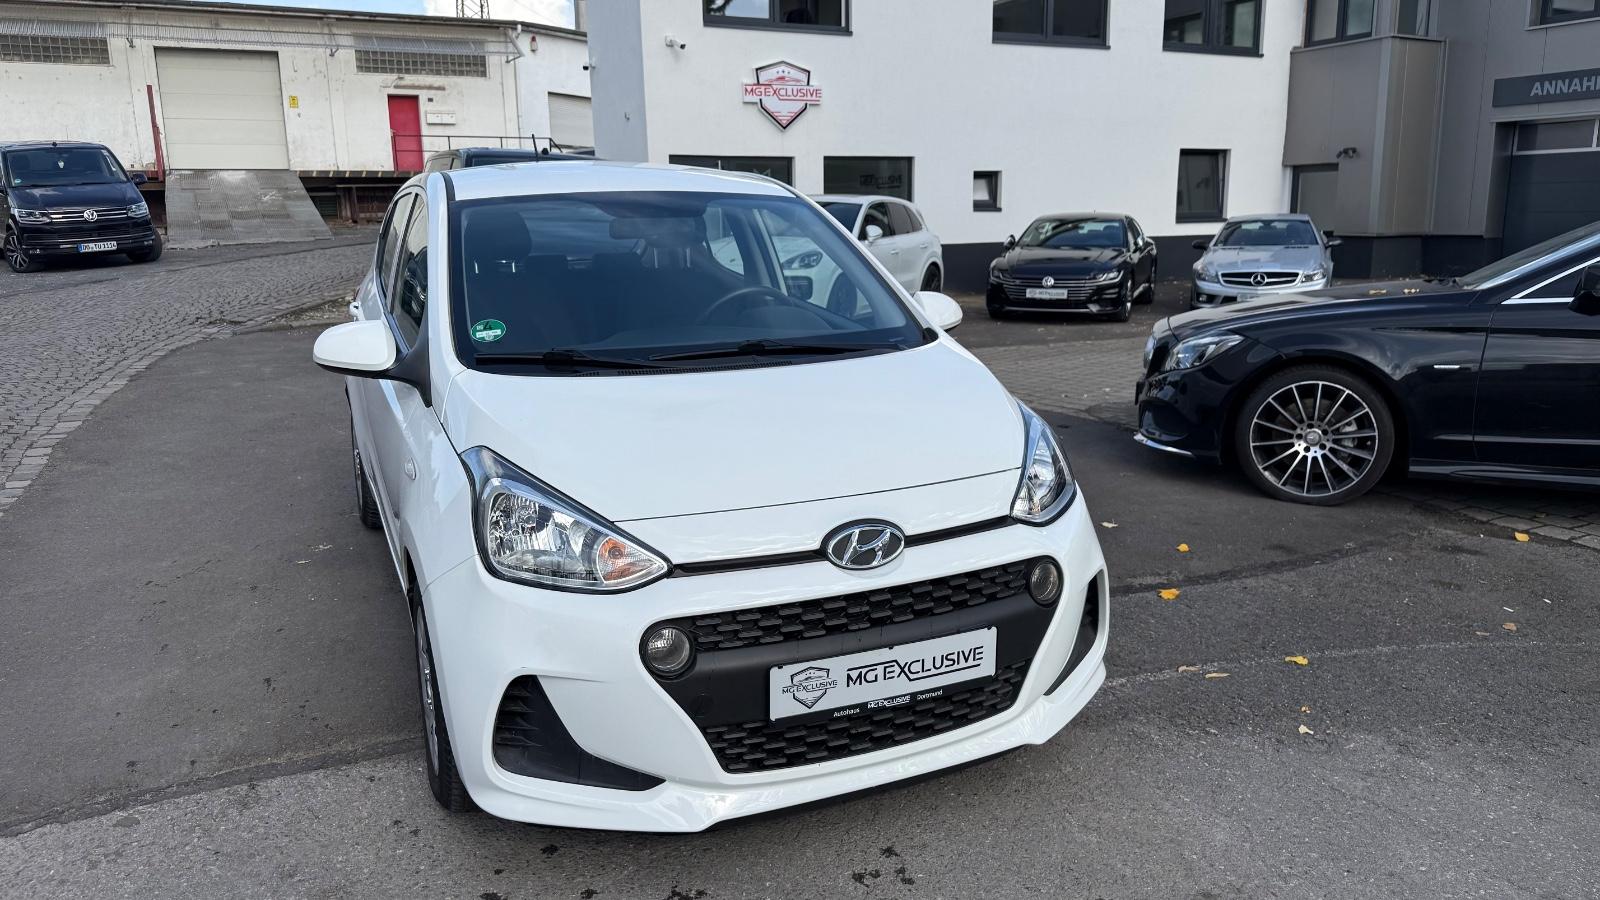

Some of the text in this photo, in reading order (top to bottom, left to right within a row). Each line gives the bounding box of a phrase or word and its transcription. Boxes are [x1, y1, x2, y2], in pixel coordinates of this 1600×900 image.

[764, 86, 822, 99] EXCLUSIVE
[1530, 75, 1600, 97] ANNAH
[847, 645, 984, 687] MG EXCLUSIVE
[833, 707, 860, 717] Autohaus
[916, 689, 943, 700] Dortmund
